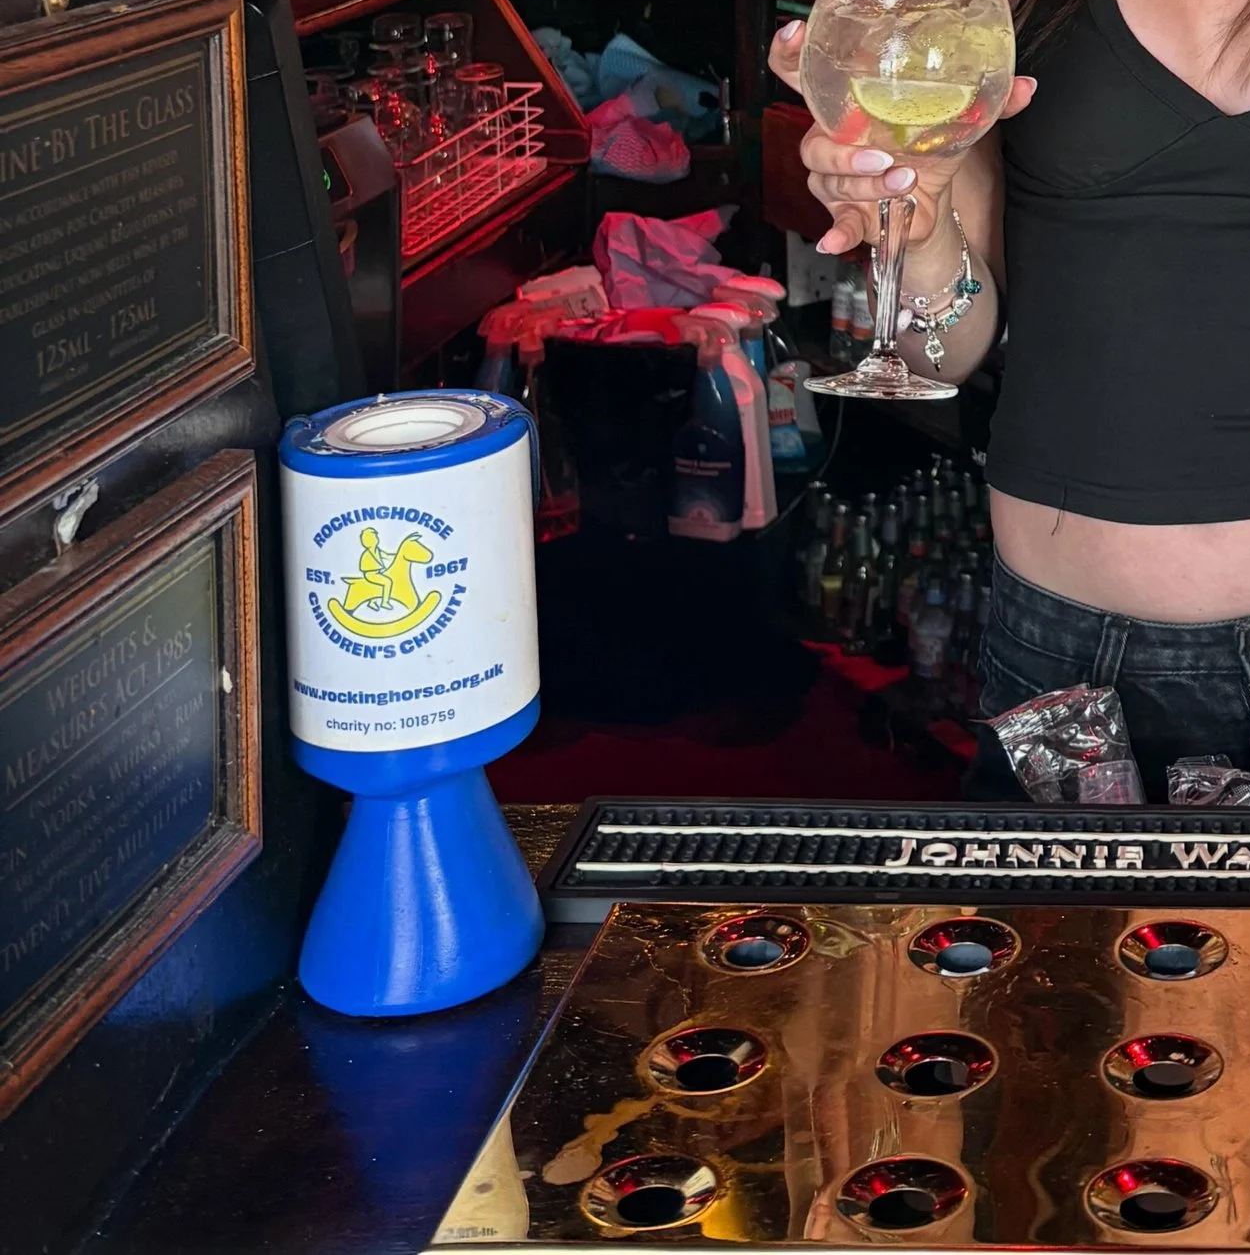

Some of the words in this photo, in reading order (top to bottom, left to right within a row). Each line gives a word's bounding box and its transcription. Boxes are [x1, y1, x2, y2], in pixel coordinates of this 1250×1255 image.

[52, 126, 78, 165] BY
[84, 108, 131, 150] THE
[137, 85, 195, 133] GLASS
[35, 331, 93, 379] 125ML
[110, 297, 158, 340] 175ML
[313, 506, 455, 549] ROCKINGHORSE
[306, 567, 335, 585] EST.
[425, 557, 469, 579] 1967
[308, 591, 397, 659] CHILDREN'S
[399, 583, 467, 655] CHARITY
[46, 633, 139, 717] WEIGHTS
[142, 614, 158, 643] &
[293, 662, 504, 706] www.rockinghorse.org.uk
[5, 699, 108, 795] MEASURES
[113, 667, 151, 706] ACT
[154, 623, 194, 675] 1985
[326, 716, 371, 735] charity
[374, 716, 396, 732] no:
[400, 708, 456, 730] 1018759
[885, 838, 1143, 870] JOHNNIE
